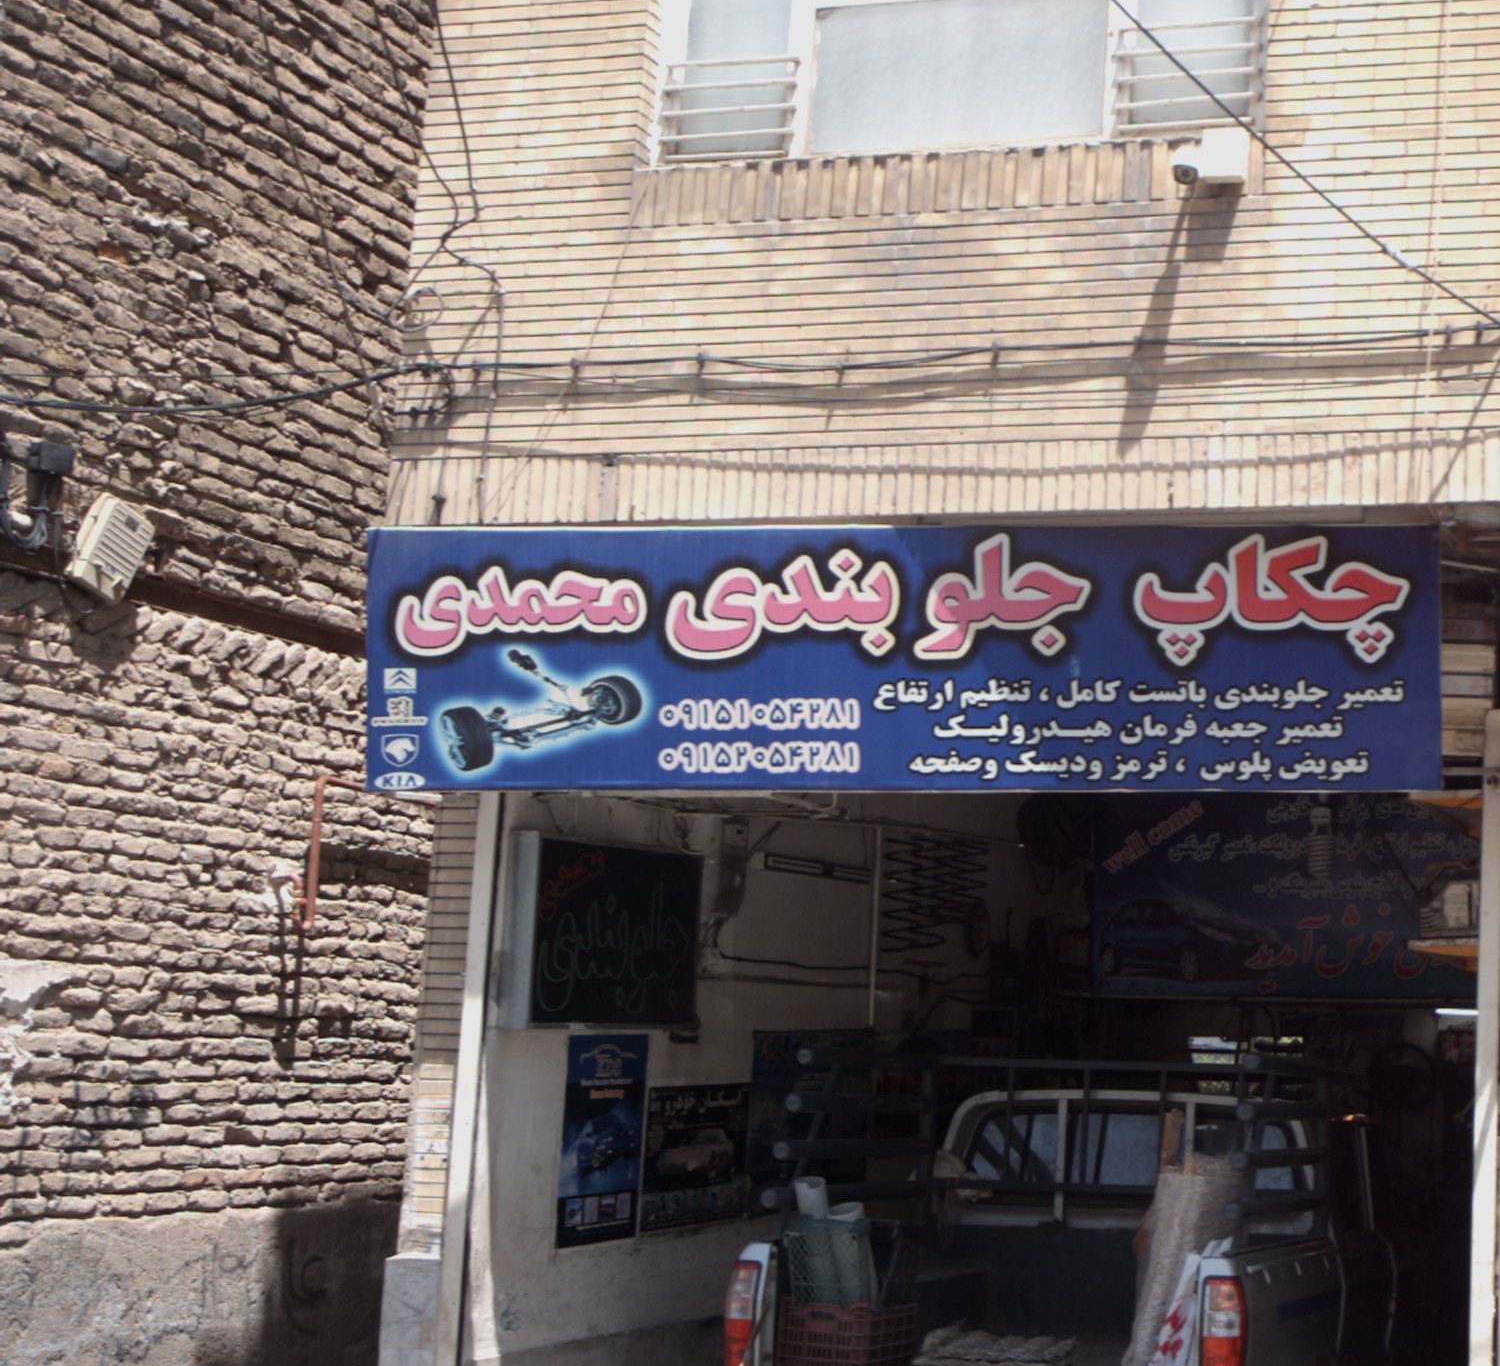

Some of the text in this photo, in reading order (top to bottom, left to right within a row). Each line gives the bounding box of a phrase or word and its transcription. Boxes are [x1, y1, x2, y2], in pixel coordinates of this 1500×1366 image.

[396, 533, 1410, 666] چکاپ جلو بندی محمدی
[873, 679, 955, 711] ارتفاع
[960, 678, 1032, 709] تنظیم
[1213, 680, 1329, 710] جلوبندی
[1337, 680, 1405, 710] تعمیر
[933, 712, 1344, 745] تعمیر جعبه فرمان هیدرولیک
[1110, 750, 1168, 781] ترمز
[1278, 751, 1369, 781] تعویض
[1244, 913, 1332, 995] آمدید
[1315, 902, 1395, 979] خوش
